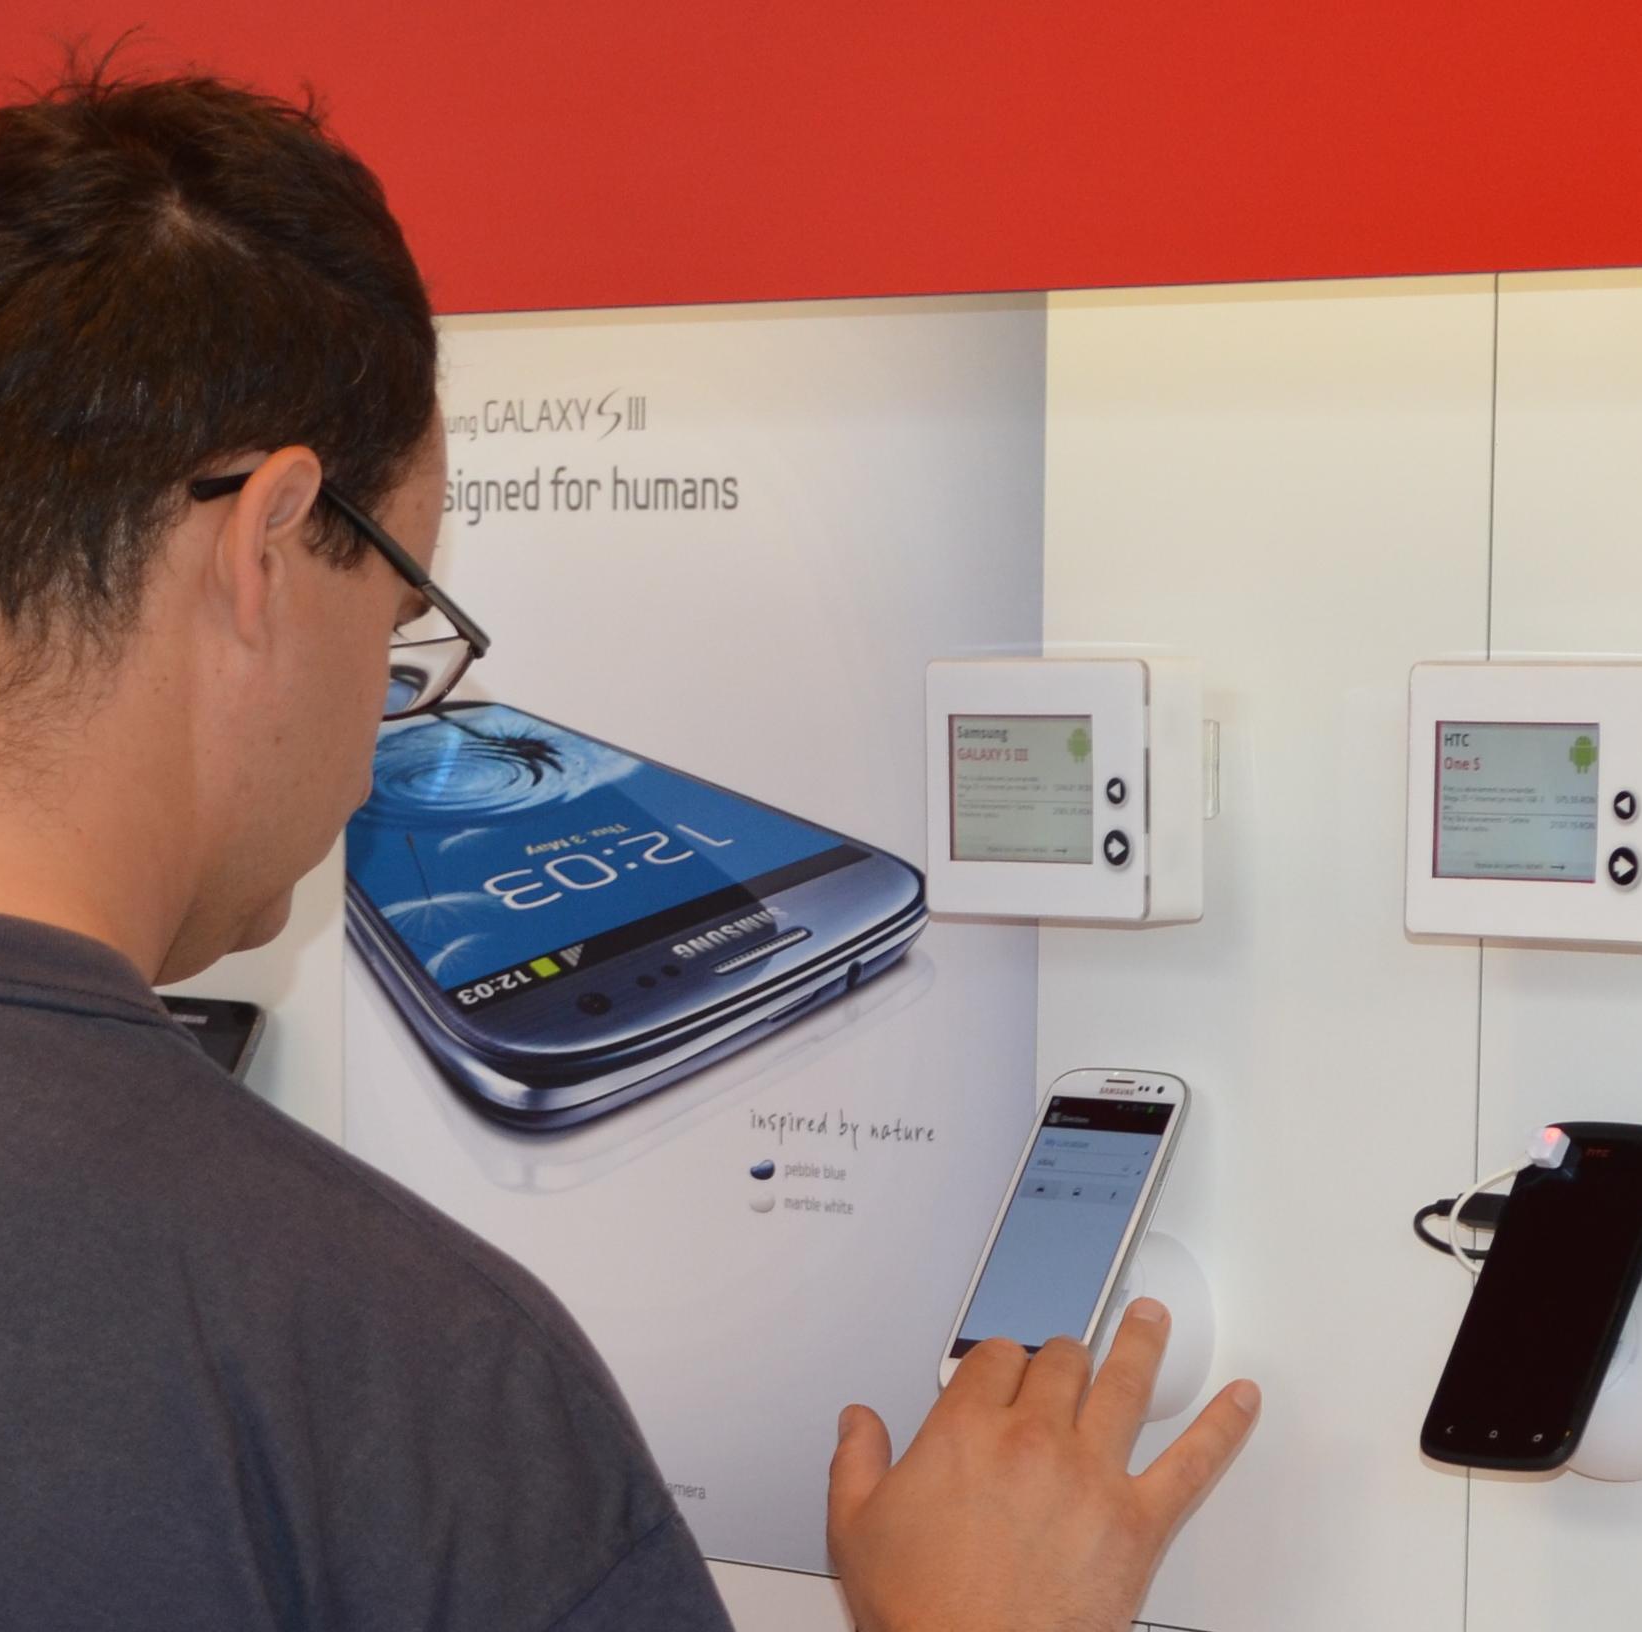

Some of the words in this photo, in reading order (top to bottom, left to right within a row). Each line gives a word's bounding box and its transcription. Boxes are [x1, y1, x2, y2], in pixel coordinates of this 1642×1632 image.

[483, 397, 592, 434] GALAXY
[596, 387, 623, 441] S
[443, 466, 540, 525] signed
[550, 465, 601, 511] for
[612, 465, 739, 511] humans
[957, 726, 1008, 743] Samsung
[1443, 733, 1470, 748] HTC
[1443, 757, 1470, 771] One
[483, 822, 734, 911] 12:03
[672, 906, 789, 959] SAMSUNG
[458, 970, 532, 1006] 12:03
[750, 1108, 828, 1145] inspired
[839, 1109, 860, 1151] by
[870, 1117, 936, 1143] nature
[784, 1163, 820, 1179] pebble
[823, 1165, 847, 1181] blue
